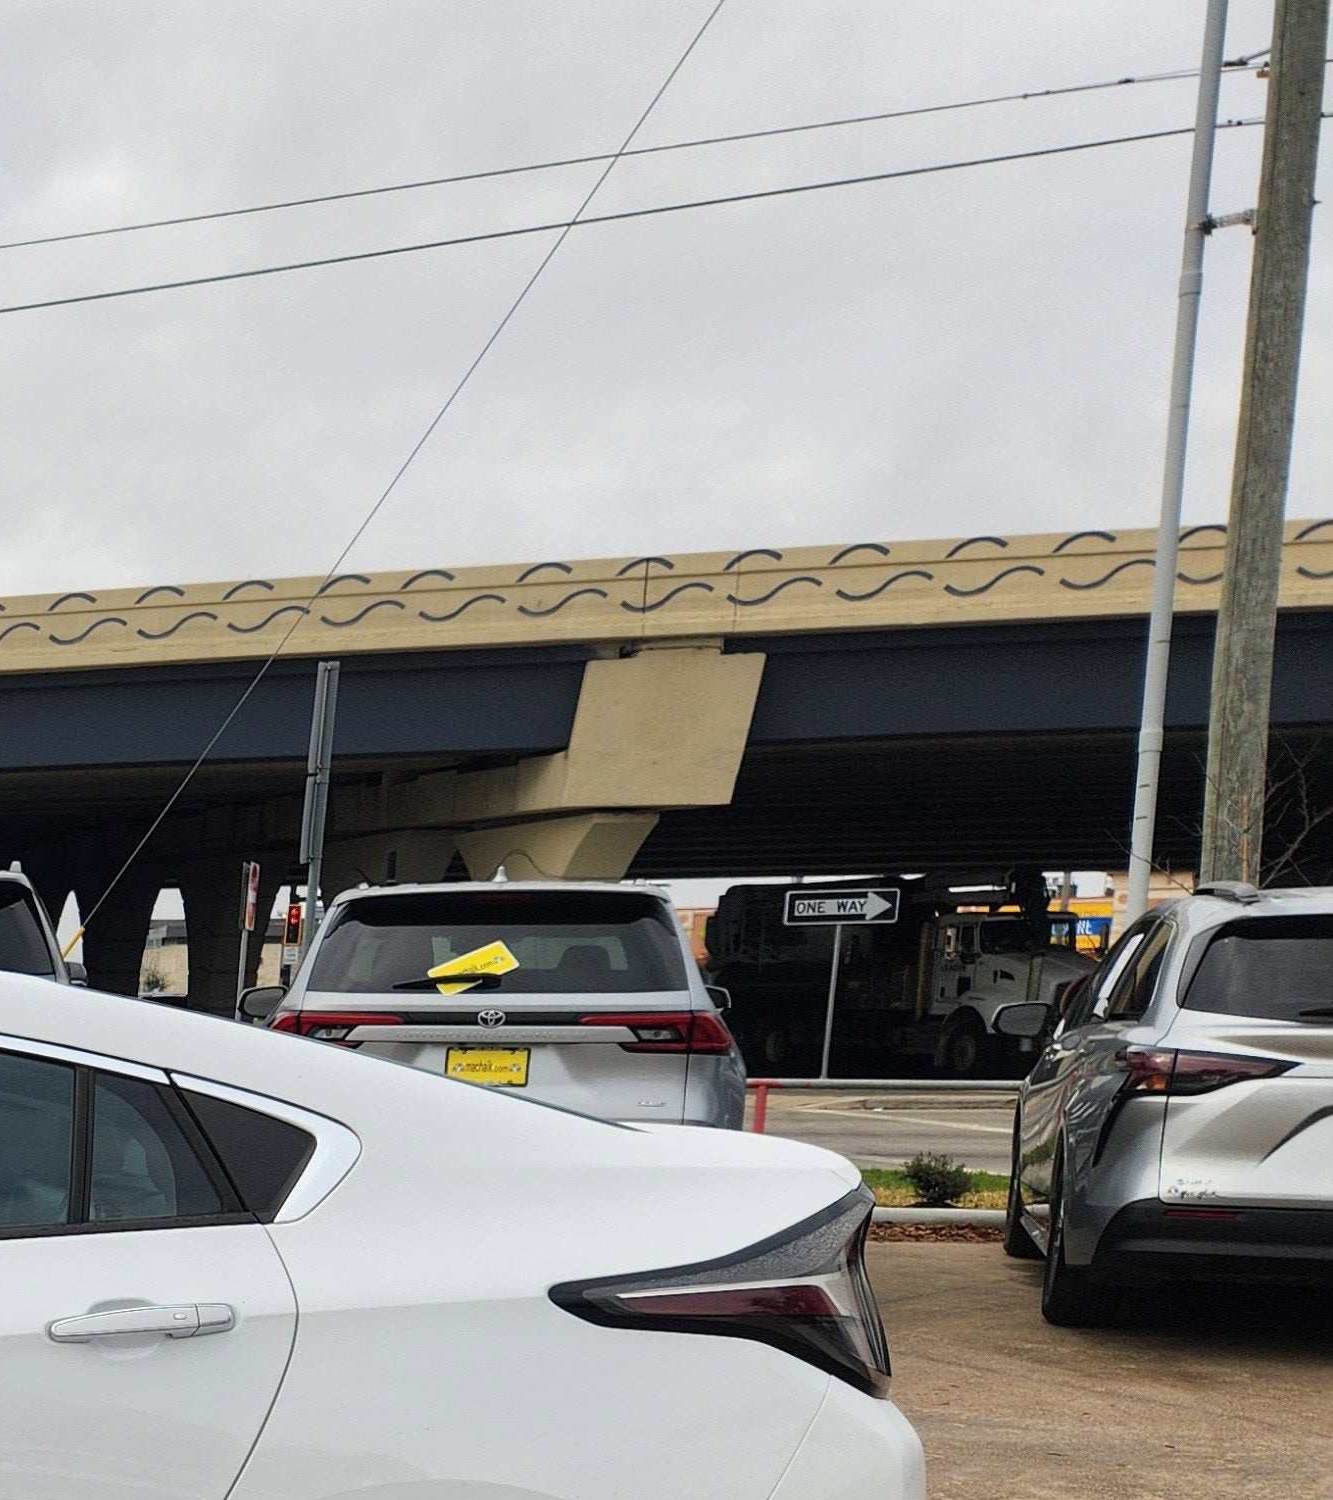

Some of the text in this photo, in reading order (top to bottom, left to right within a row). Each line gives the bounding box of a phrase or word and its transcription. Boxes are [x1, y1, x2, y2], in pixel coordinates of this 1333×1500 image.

[796, 900, 868, 914] ONE WAY
[465, 1060, 509, 1073] machaik.com
